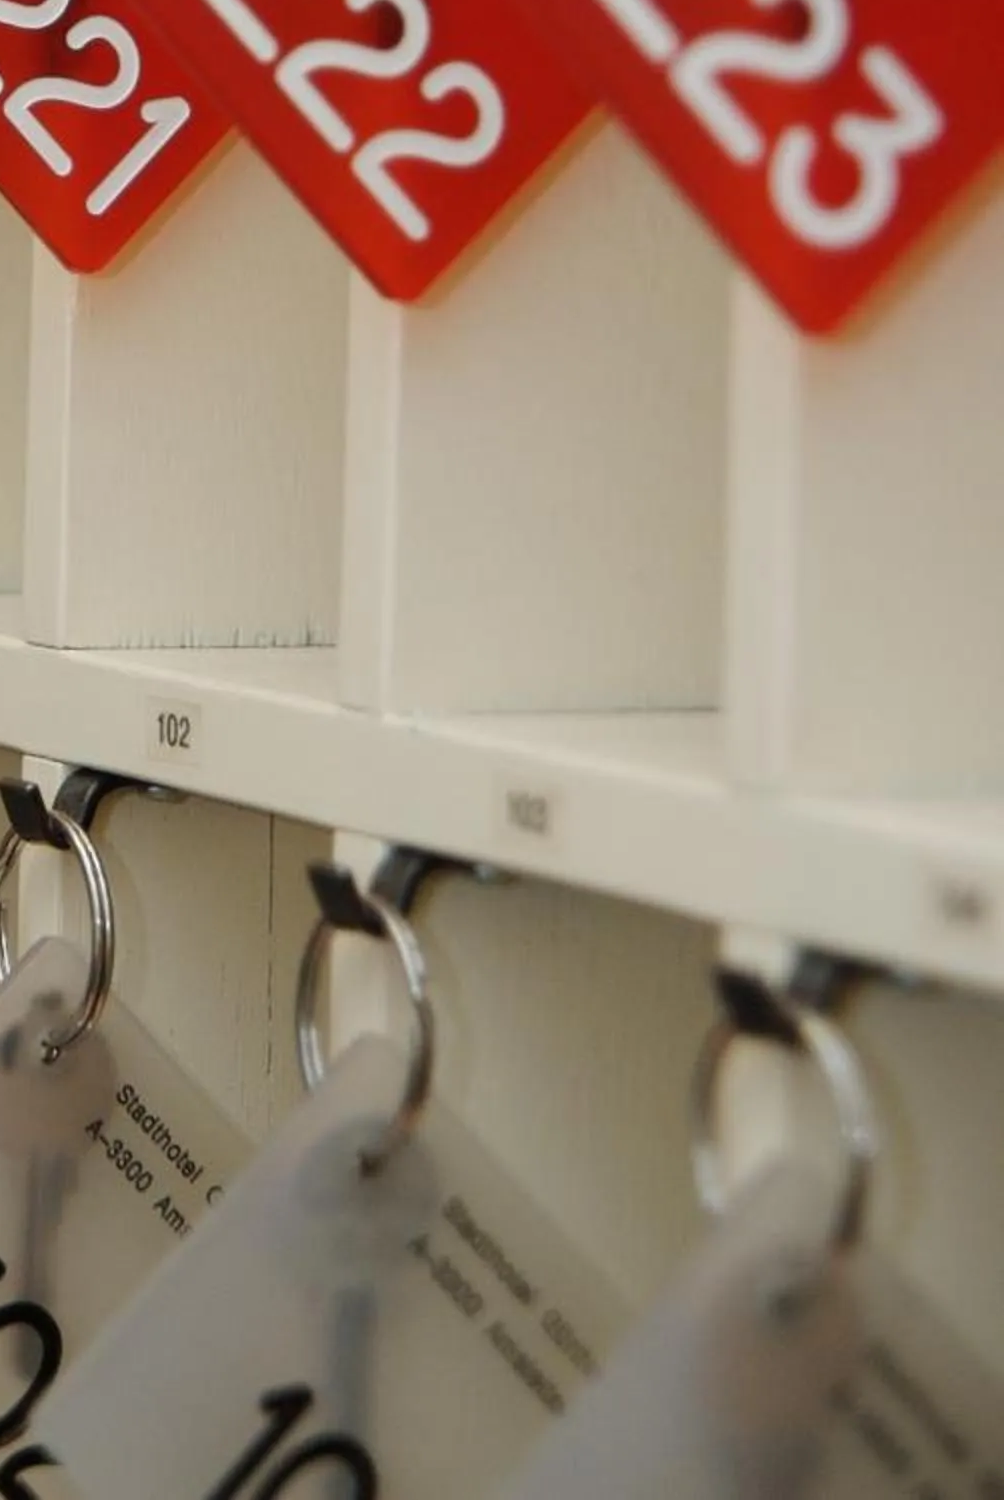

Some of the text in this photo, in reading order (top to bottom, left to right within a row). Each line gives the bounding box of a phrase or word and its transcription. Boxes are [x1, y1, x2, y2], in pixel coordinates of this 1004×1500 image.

[156, 712, 192, 749] 102
[85, 1119, 154, 1193] A-3300
[116, 1083, 204, 1185] Stadthotel
